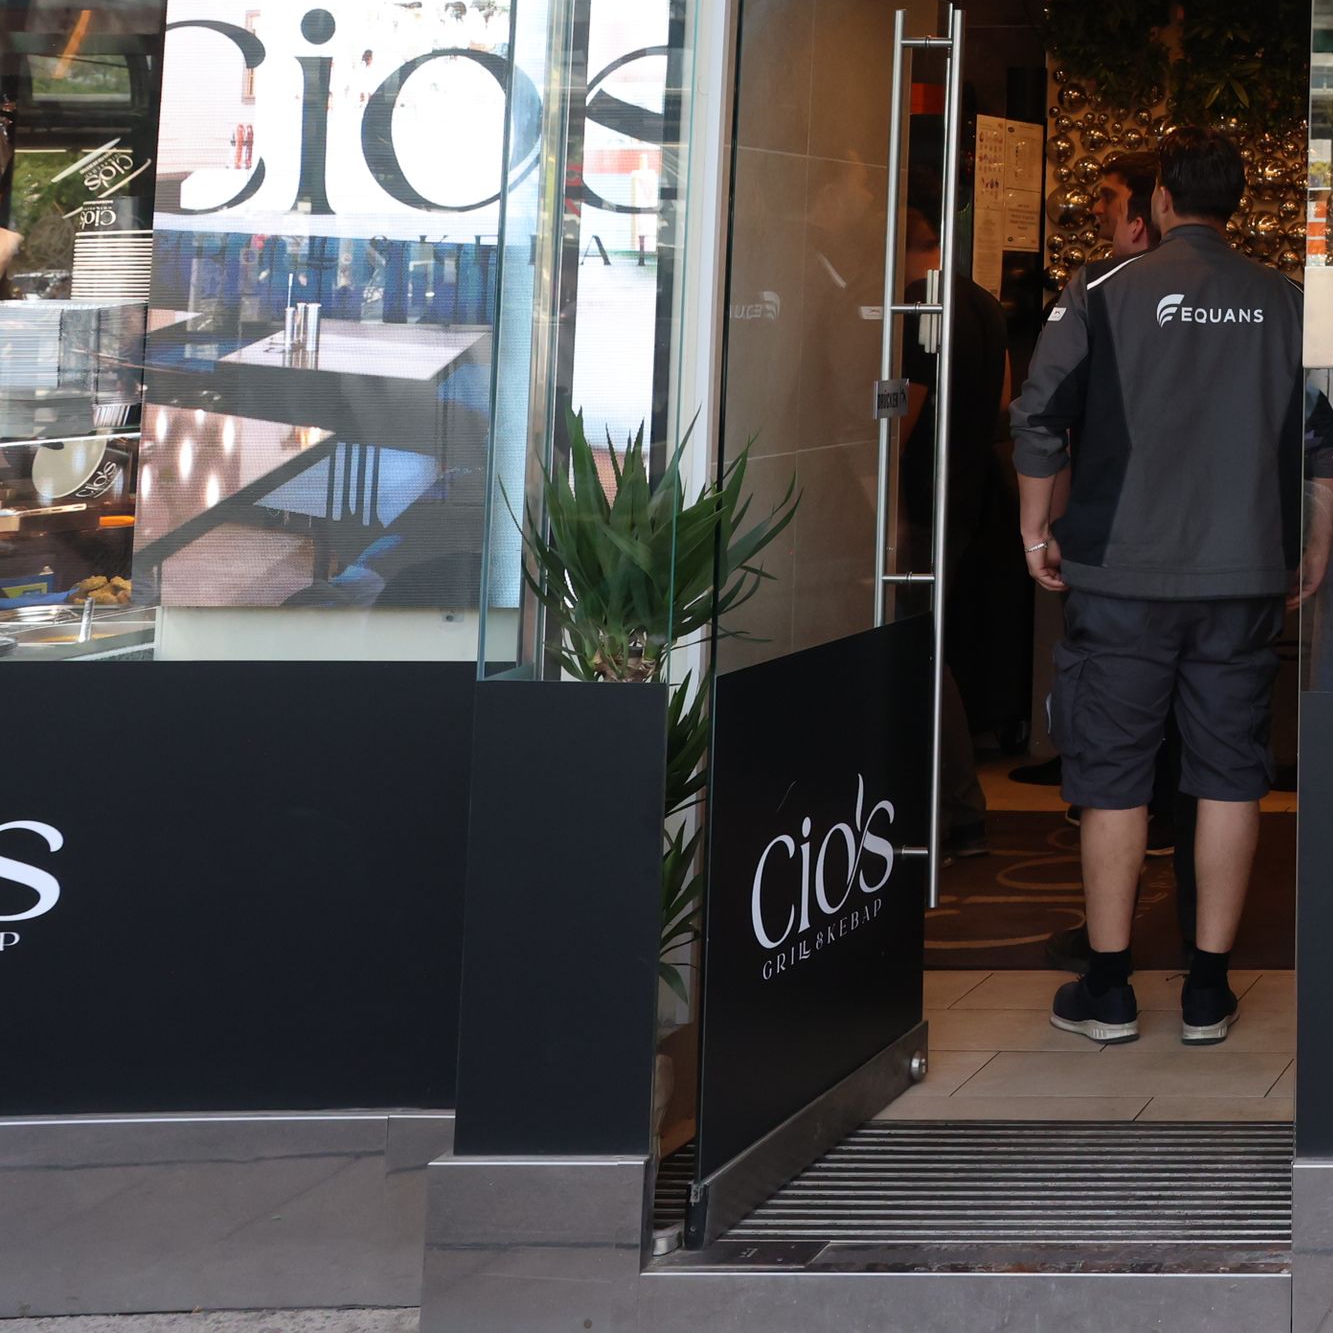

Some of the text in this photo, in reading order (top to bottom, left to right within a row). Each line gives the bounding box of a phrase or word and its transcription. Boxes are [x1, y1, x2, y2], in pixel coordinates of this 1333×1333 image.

[1181, 307, 1265, 324] EQUANS
[762, 940, 813, 980] GRILL
[826, 897, 883, 945] KEBAP
